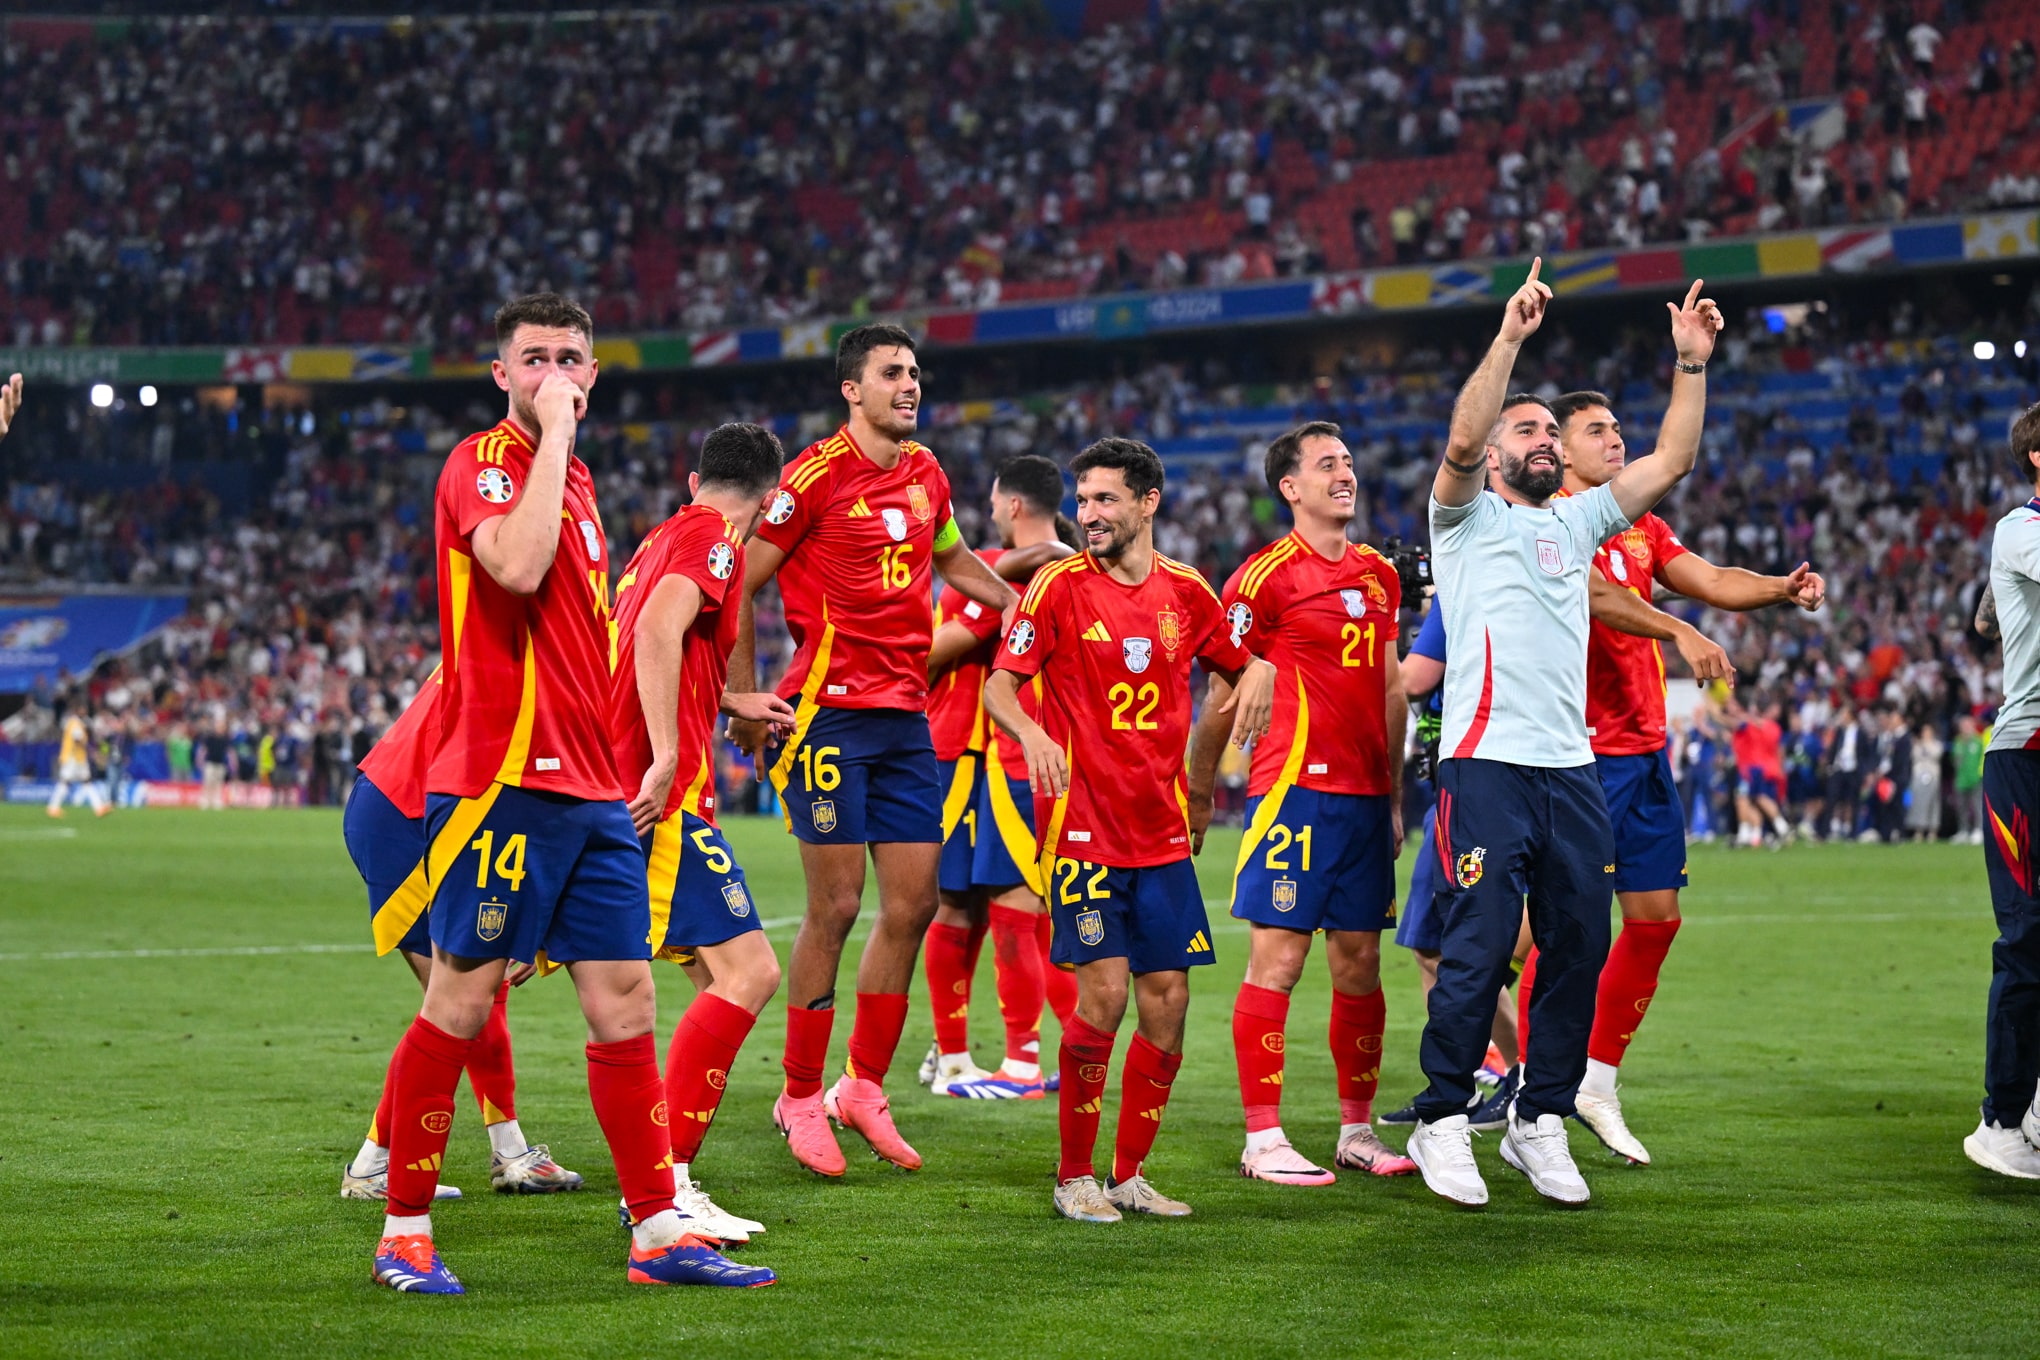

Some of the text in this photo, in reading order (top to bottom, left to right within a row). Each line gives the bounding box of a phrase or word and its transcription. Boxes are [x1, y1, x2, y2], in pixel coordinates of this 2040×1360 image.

[877, 544, 913, 590] 16
[1341, 622, 1376, 668] 21
[1108, 681, 1160, 730] 22
[798, 744, 841, 792] 16
[471, 829, 527, 892] 14
[690, 828, 732, 874] 5
[1265, 823, 1312, 872] 21
[1055, 857, 1111, 906] 22
